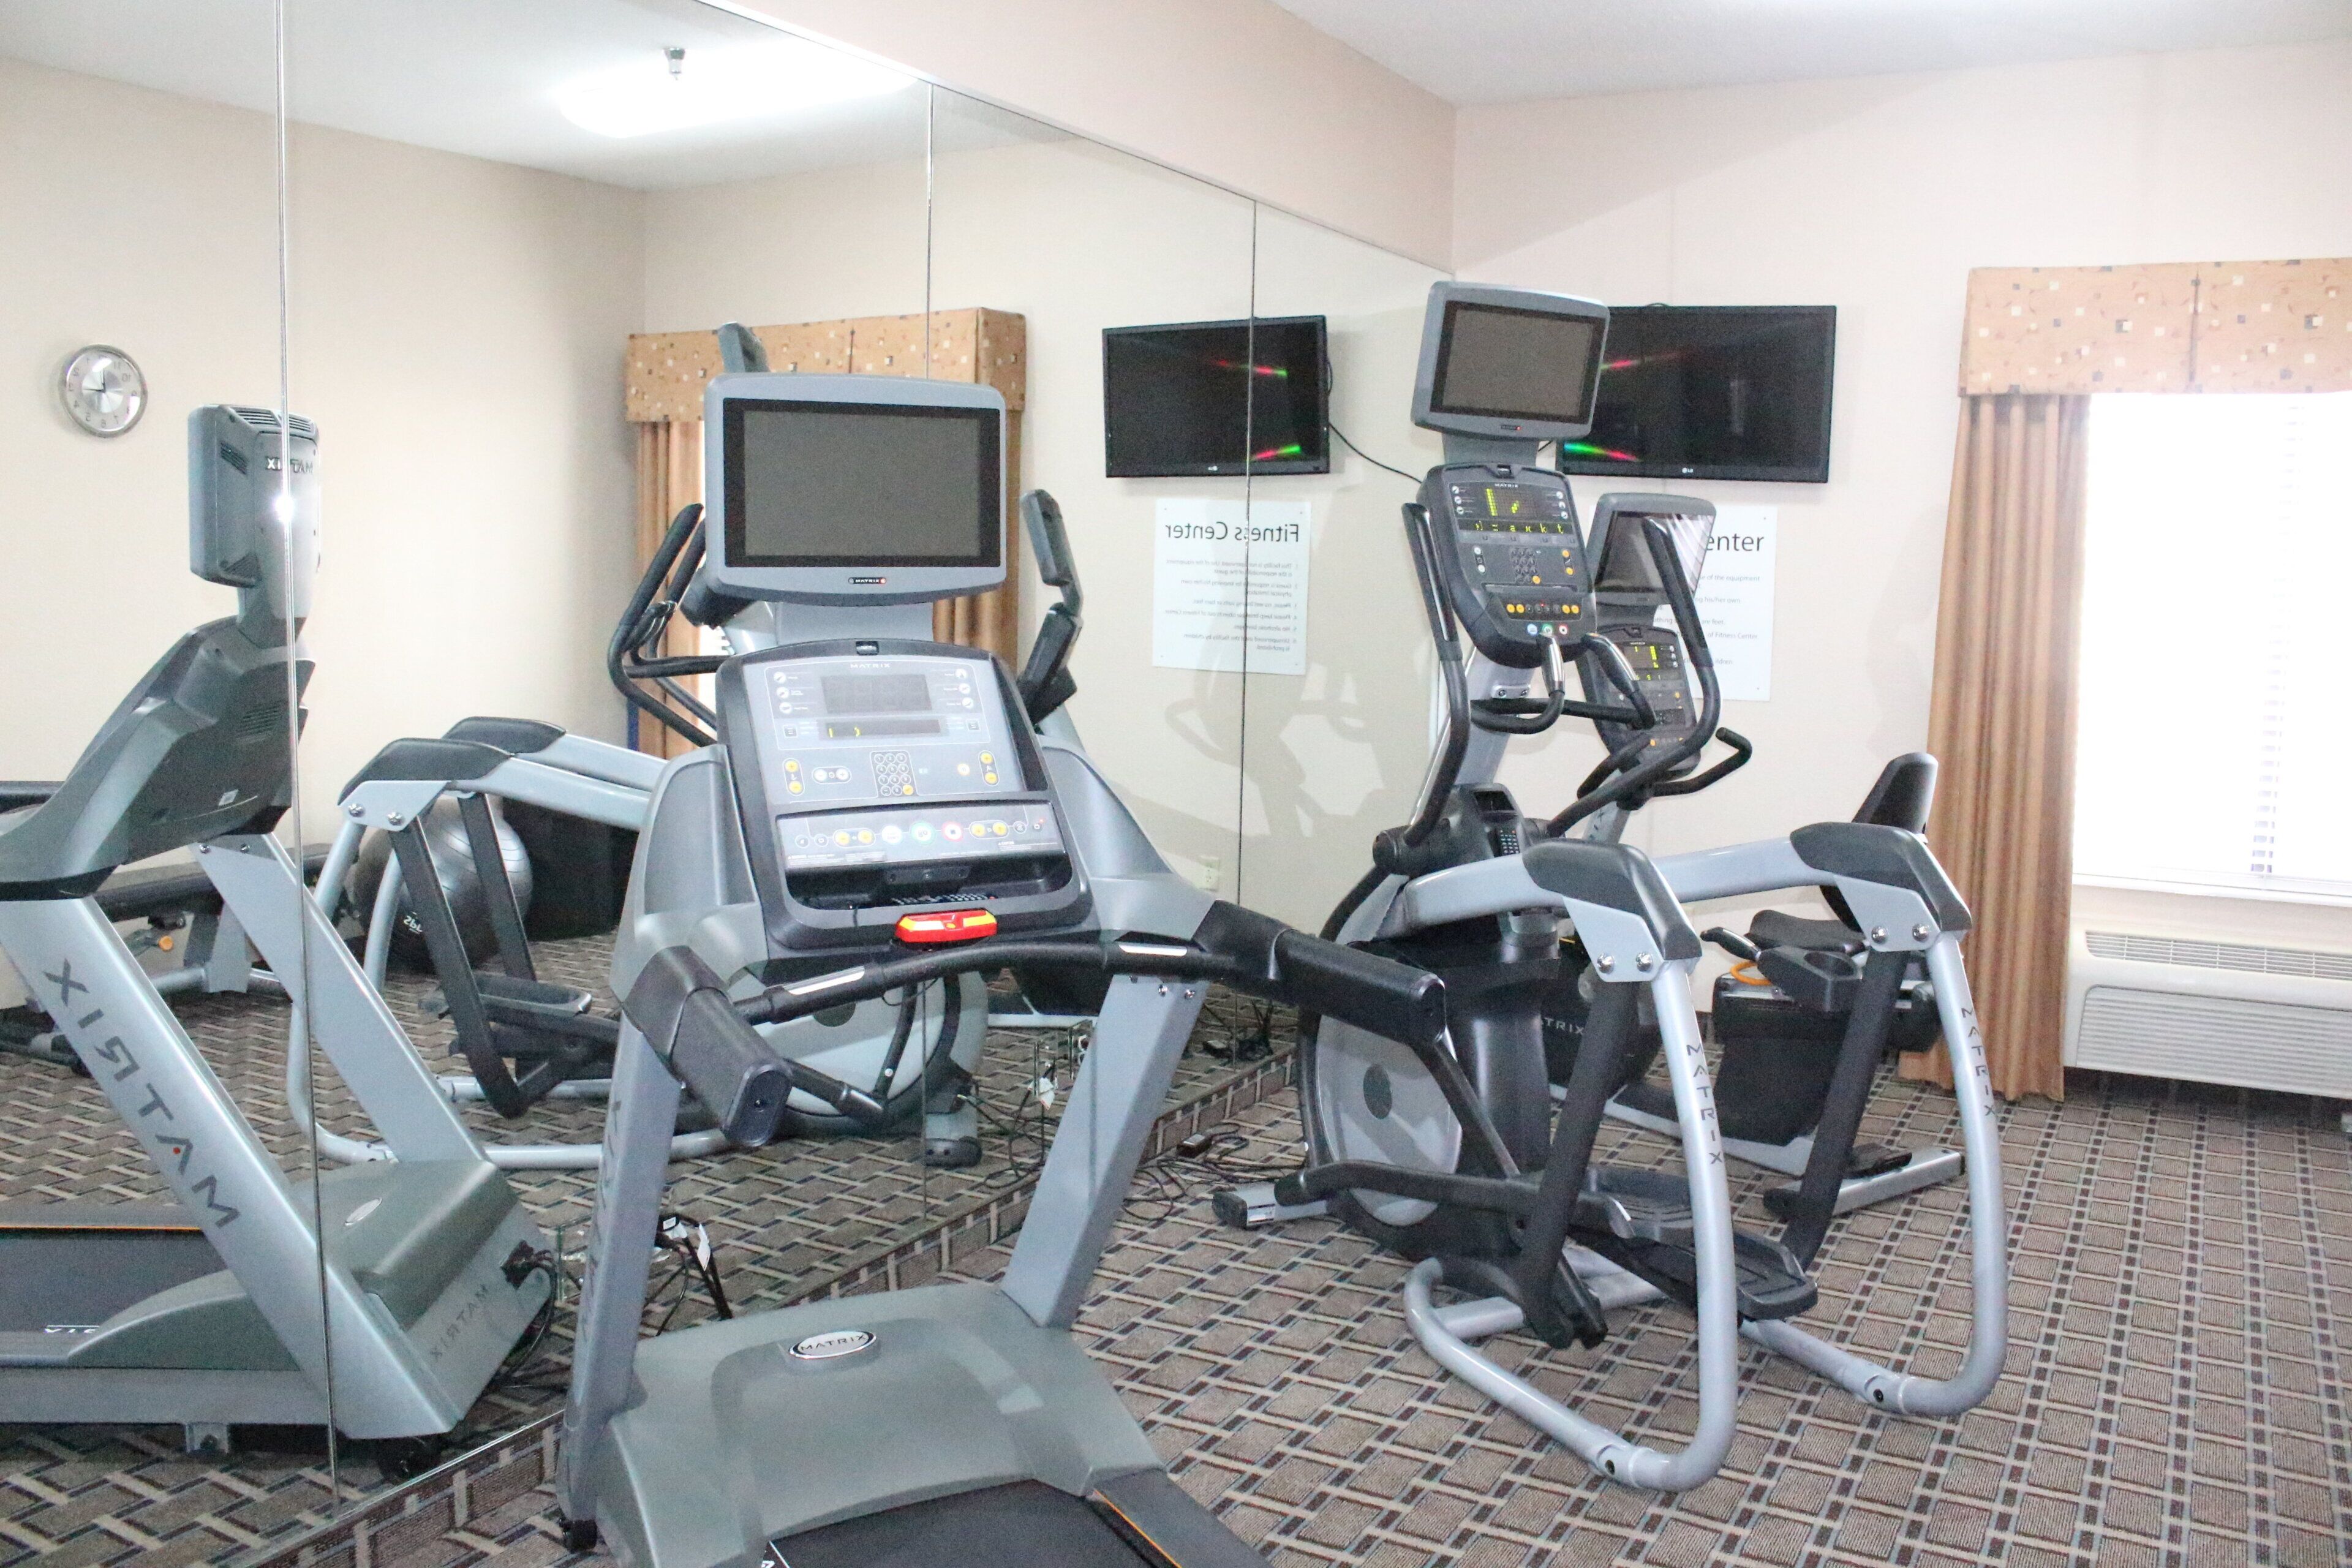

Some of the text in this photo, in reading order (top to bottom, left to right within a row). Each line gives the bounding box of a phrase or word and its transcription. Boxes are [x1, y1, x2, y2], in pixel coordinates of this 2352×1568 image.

[1706, 533, 1764, 551] enter
[1542, 1017, 1585, 1036] TRIX
[1961, 1006, 1997, 1117] MATRIX
[1686, 1042, 1724, 1165] MATRIX
[801, 1334, 866, 1351] MATRIX
